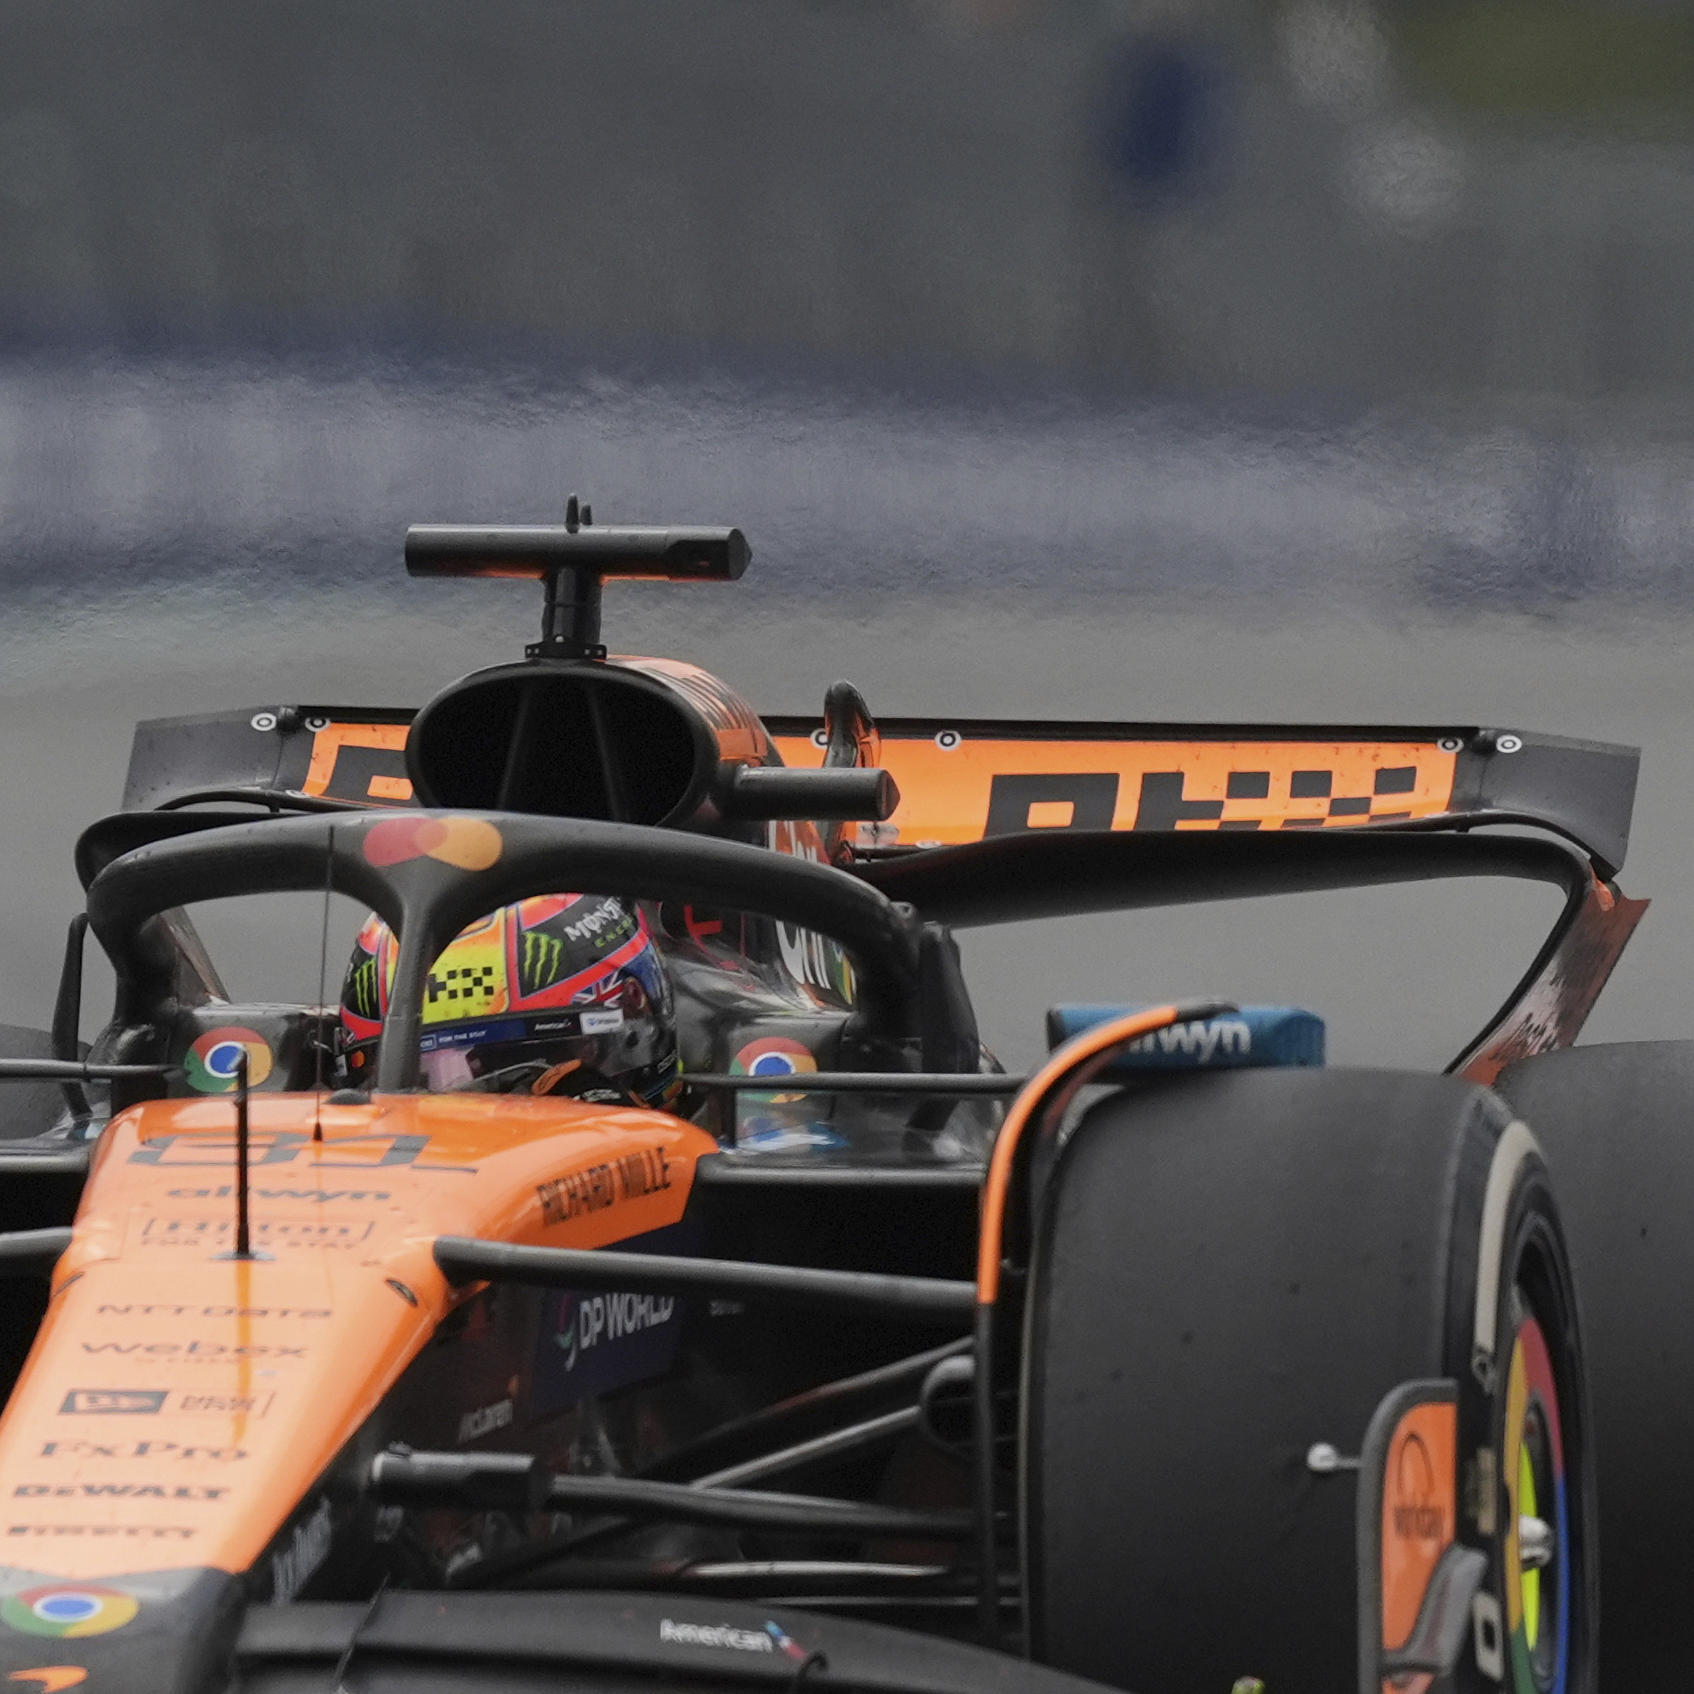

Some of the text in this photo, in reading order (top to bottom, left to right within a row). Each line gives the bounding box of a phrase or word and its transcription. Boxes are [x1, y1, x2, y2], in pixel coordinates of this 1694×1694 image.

[167, 1185, 391, 1203] alwyn
[536, 1146, 671, 1227] RICHARD MILLE
[166, 1218, 353, 1234] Hiton
[579, 1297, 604, 1350] DP
[80, 1339, 308, 1357] webex
[36, 1440, 251, 1462] FxPro
[660, 1618, 773, 1653] American
